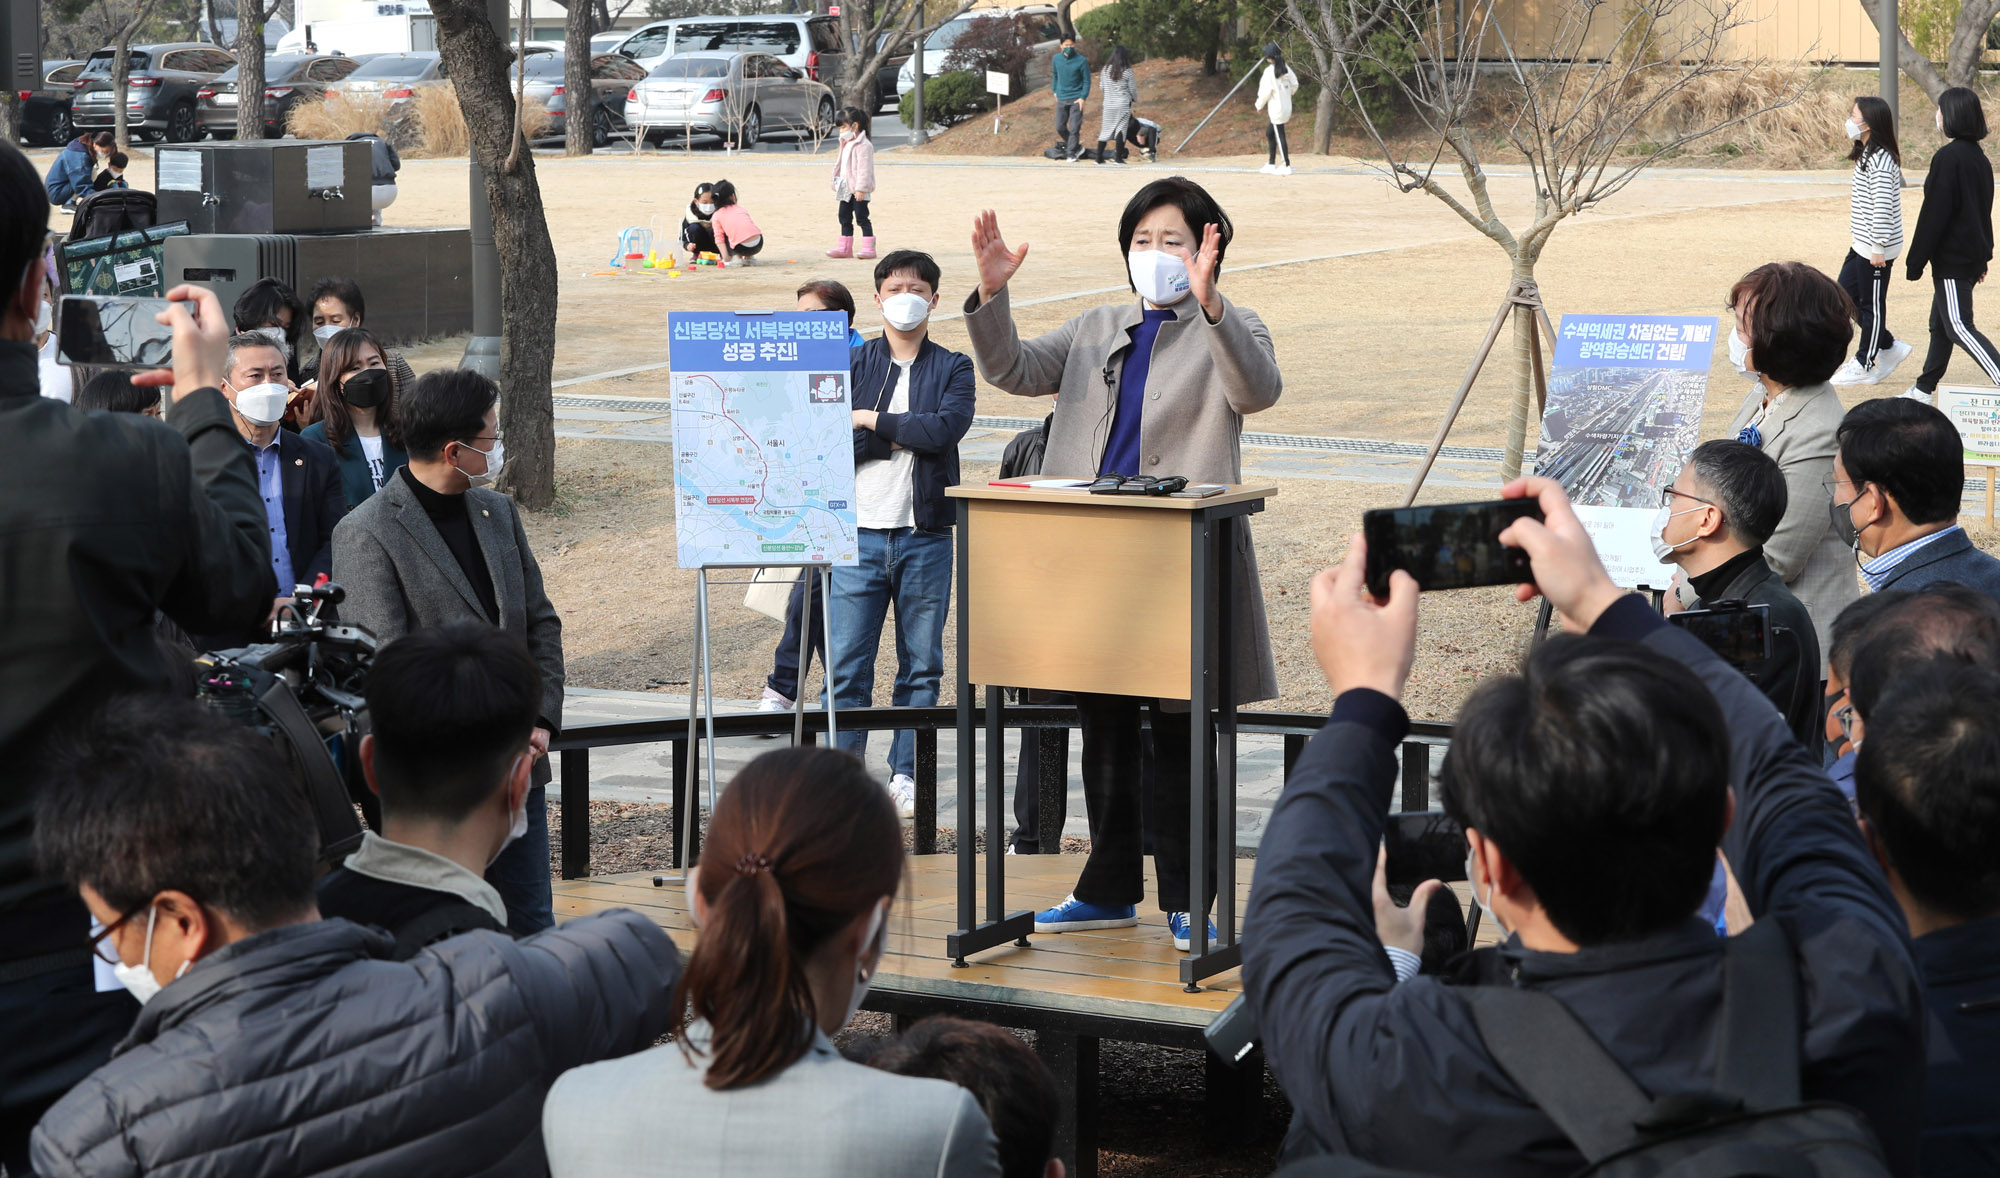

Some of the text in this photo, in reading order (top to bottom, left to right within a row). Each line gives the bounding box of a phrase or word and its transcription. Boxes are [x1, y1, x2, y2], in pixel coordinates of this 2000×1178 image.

[673, 321, 845, 341] 신분당선 서북부연장선
[1563, 322, 1712, 342] 수색역세권 차질없는 개발!
[722, 341, 798, 362] 성공 추진!
[1579, 342, 1687, 361] 광역환승센터 건립!
[766, 439, 785, 447] 서울시
